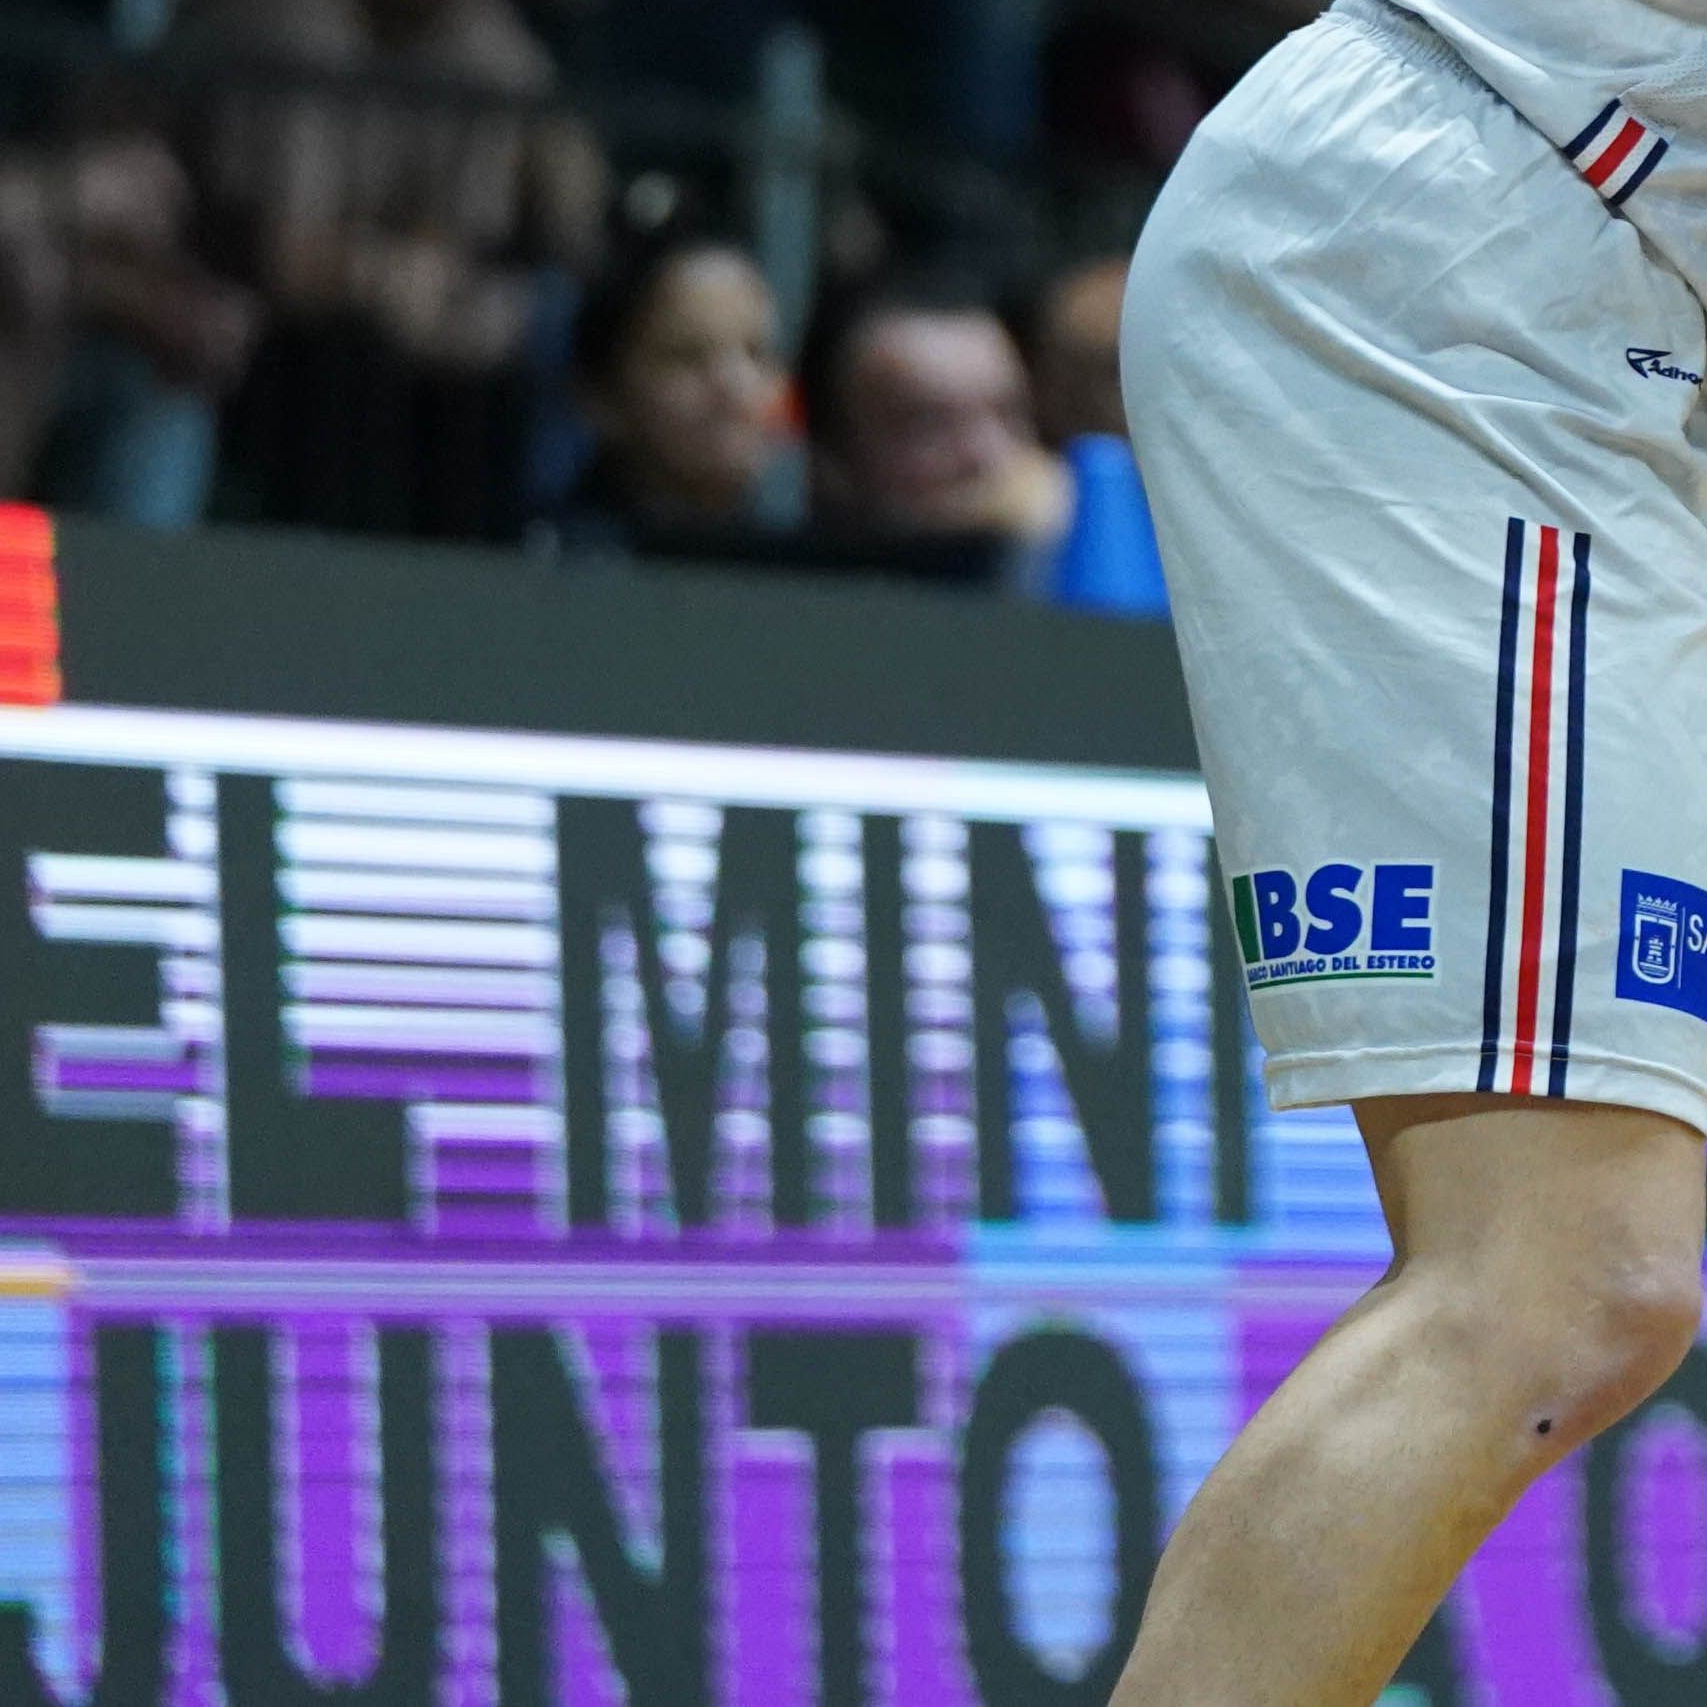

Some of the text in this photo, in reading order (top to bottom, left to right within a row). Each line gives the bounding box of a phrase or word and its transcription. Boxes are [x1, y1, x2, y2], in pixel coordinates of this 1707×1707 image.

[0, 758, 408, 1223] EL
[1252, 863, 1434, 961] BSE
[1269, 957, 1327, 980] SANTIAGO
[1332, 956, 1361, 971] DEL
[1366, 955, 1435, 971] ESTERO
[0, 1318, 1168, 1707] JUNTO
